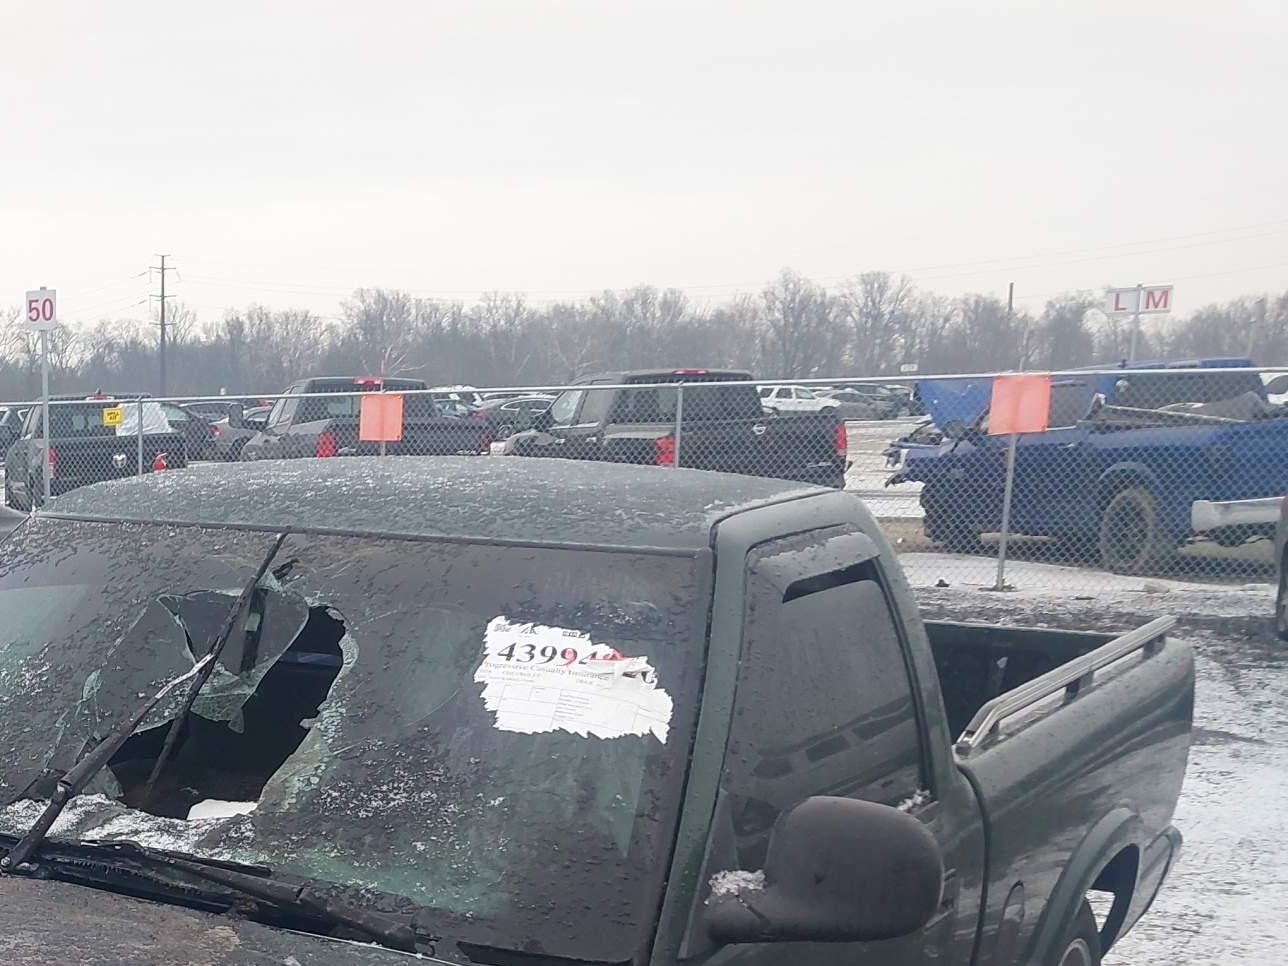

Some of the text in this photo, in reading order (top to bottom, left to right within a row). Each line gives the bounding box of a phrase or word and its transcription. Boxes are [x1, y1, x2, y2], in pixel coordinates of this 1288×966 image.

[28, 298, 54, 321] 50
[1114, 289, 1169, 311] L M
